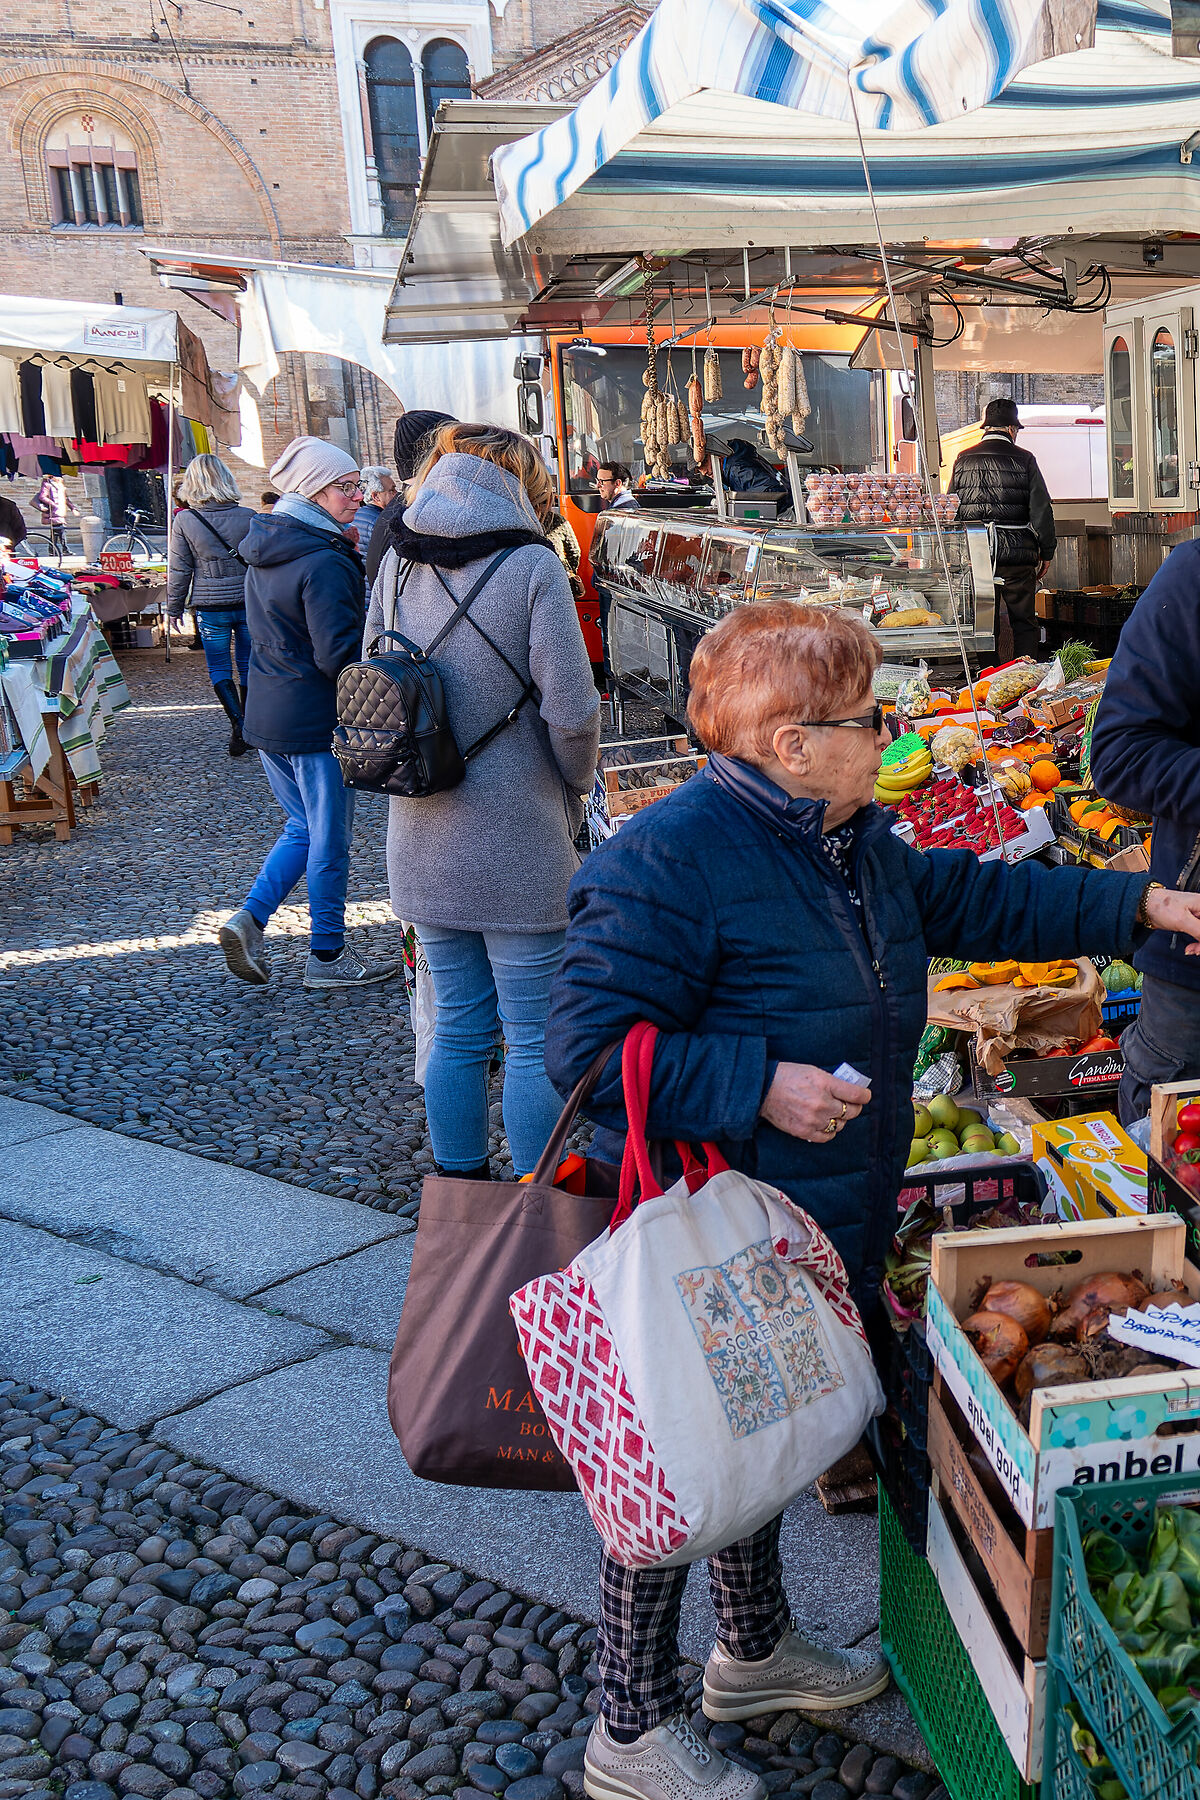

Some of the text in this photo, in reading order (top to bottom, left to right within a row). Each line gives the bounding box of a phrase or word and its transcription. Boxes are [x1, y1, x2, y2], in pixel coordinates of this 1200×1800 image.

[1068, 1056, 1127, 1086] Gandin
[1108, 1073, 1123, 1081] GUST
[485, 1387, 543, 1414] MA
[496, 1445, 555, 1463] MAN &
[968, 1395, 994, 1453] anbel
[996, 1446, 1020, 1497] gold
[1072, 1443, 1185, 1487] anbel
